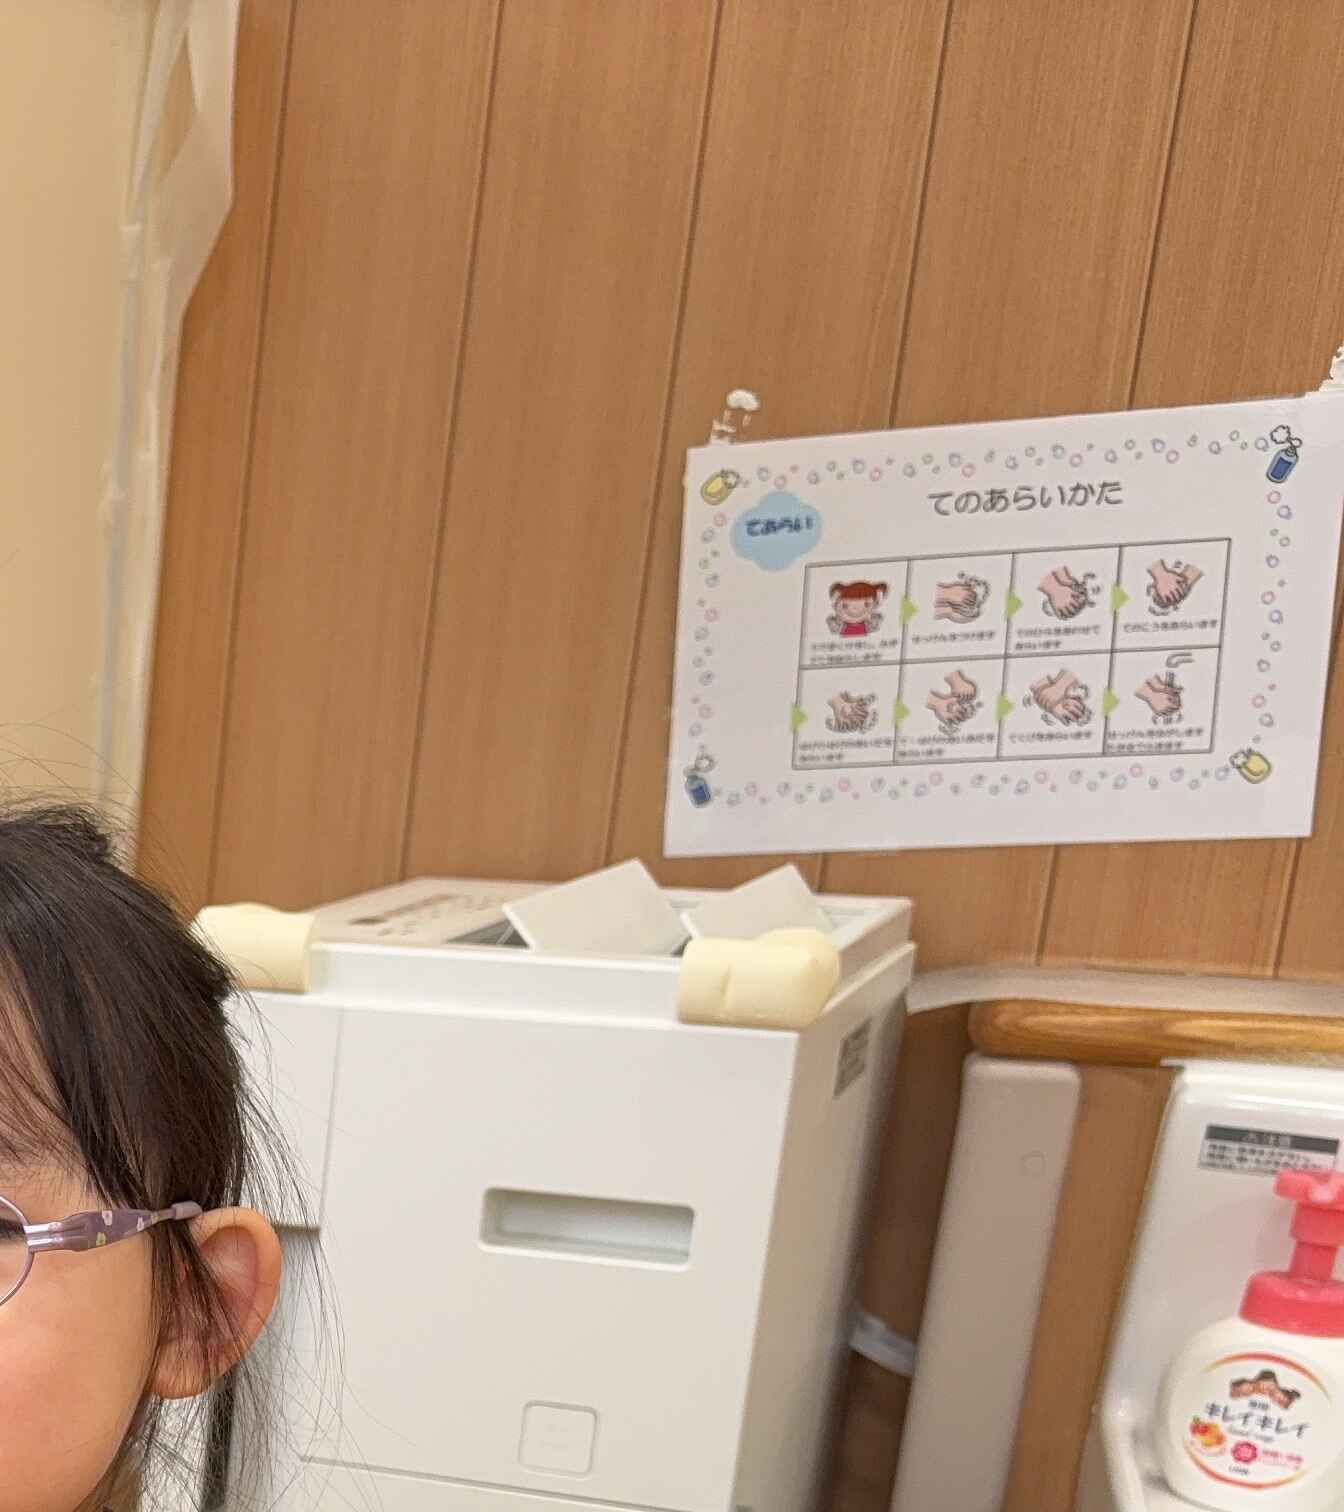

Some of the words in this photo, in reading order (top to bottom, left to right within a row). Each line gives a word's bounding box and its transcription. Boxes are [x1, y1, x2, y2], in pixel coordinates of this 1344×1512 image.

[928, 481, 1123, 516] てのあらいかた
[745, 516, 814, 537] てあらい
[1203, 1402, 1311, 1440] キレイキレイ
